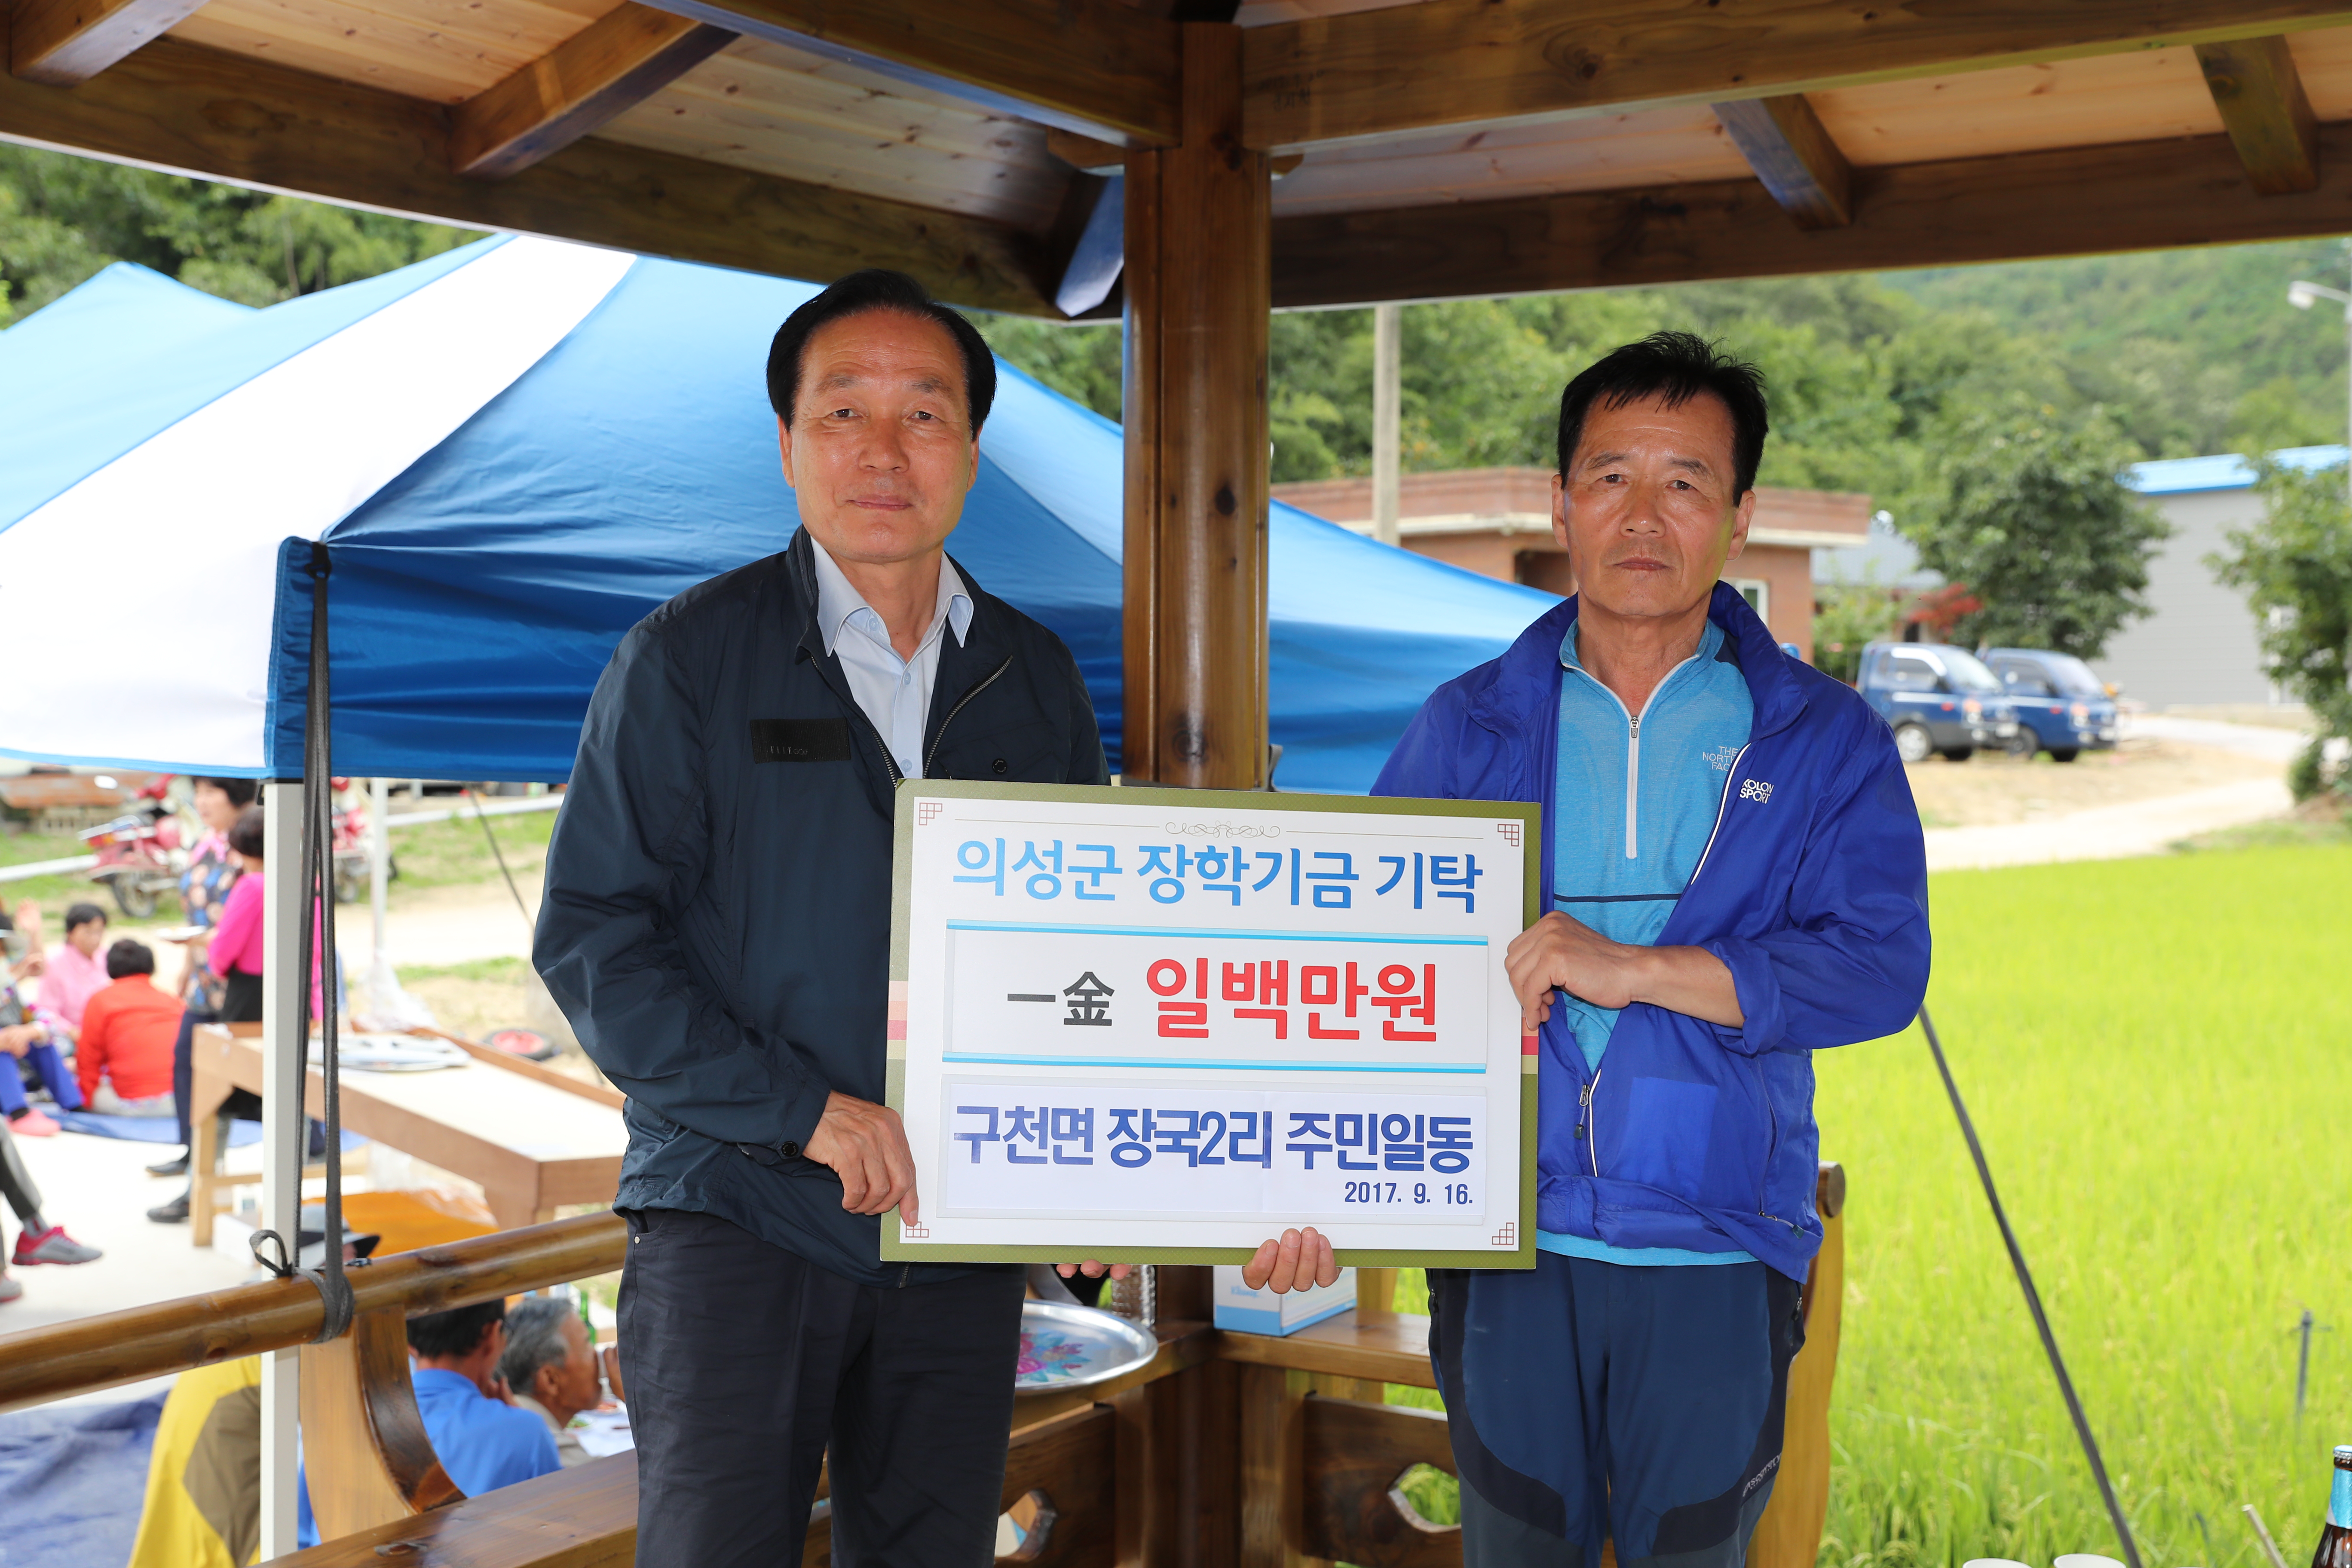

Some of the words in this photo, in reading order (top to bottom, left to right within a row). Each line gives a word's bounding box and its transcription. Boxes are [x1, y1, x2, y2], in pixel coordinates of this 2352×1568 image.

[1718, 745, 1739, 756] THE
[1739, 787, 1770, 804] SPORT
[1742, 778, 1774, 793] KOLON
[954, 838, 1122, 900] 의성군
[1137, 844, 1359, 908] 장학기금
[1376, 853, 1482, 913] 기탁
[1147, 958, 1436, 1041] 일백만원
[953, 1106, 1093, 1164] 구천면
[1108, 1109, 1272, 1168] 장국2리
[1286, 1113, 1473, 1173] 주민일동
[1344, 1181, 1402, 1204] 2017.
[1414, 1183, 1431, 1204] 9.
[1445, 1183, 1473, 1205] 16.
